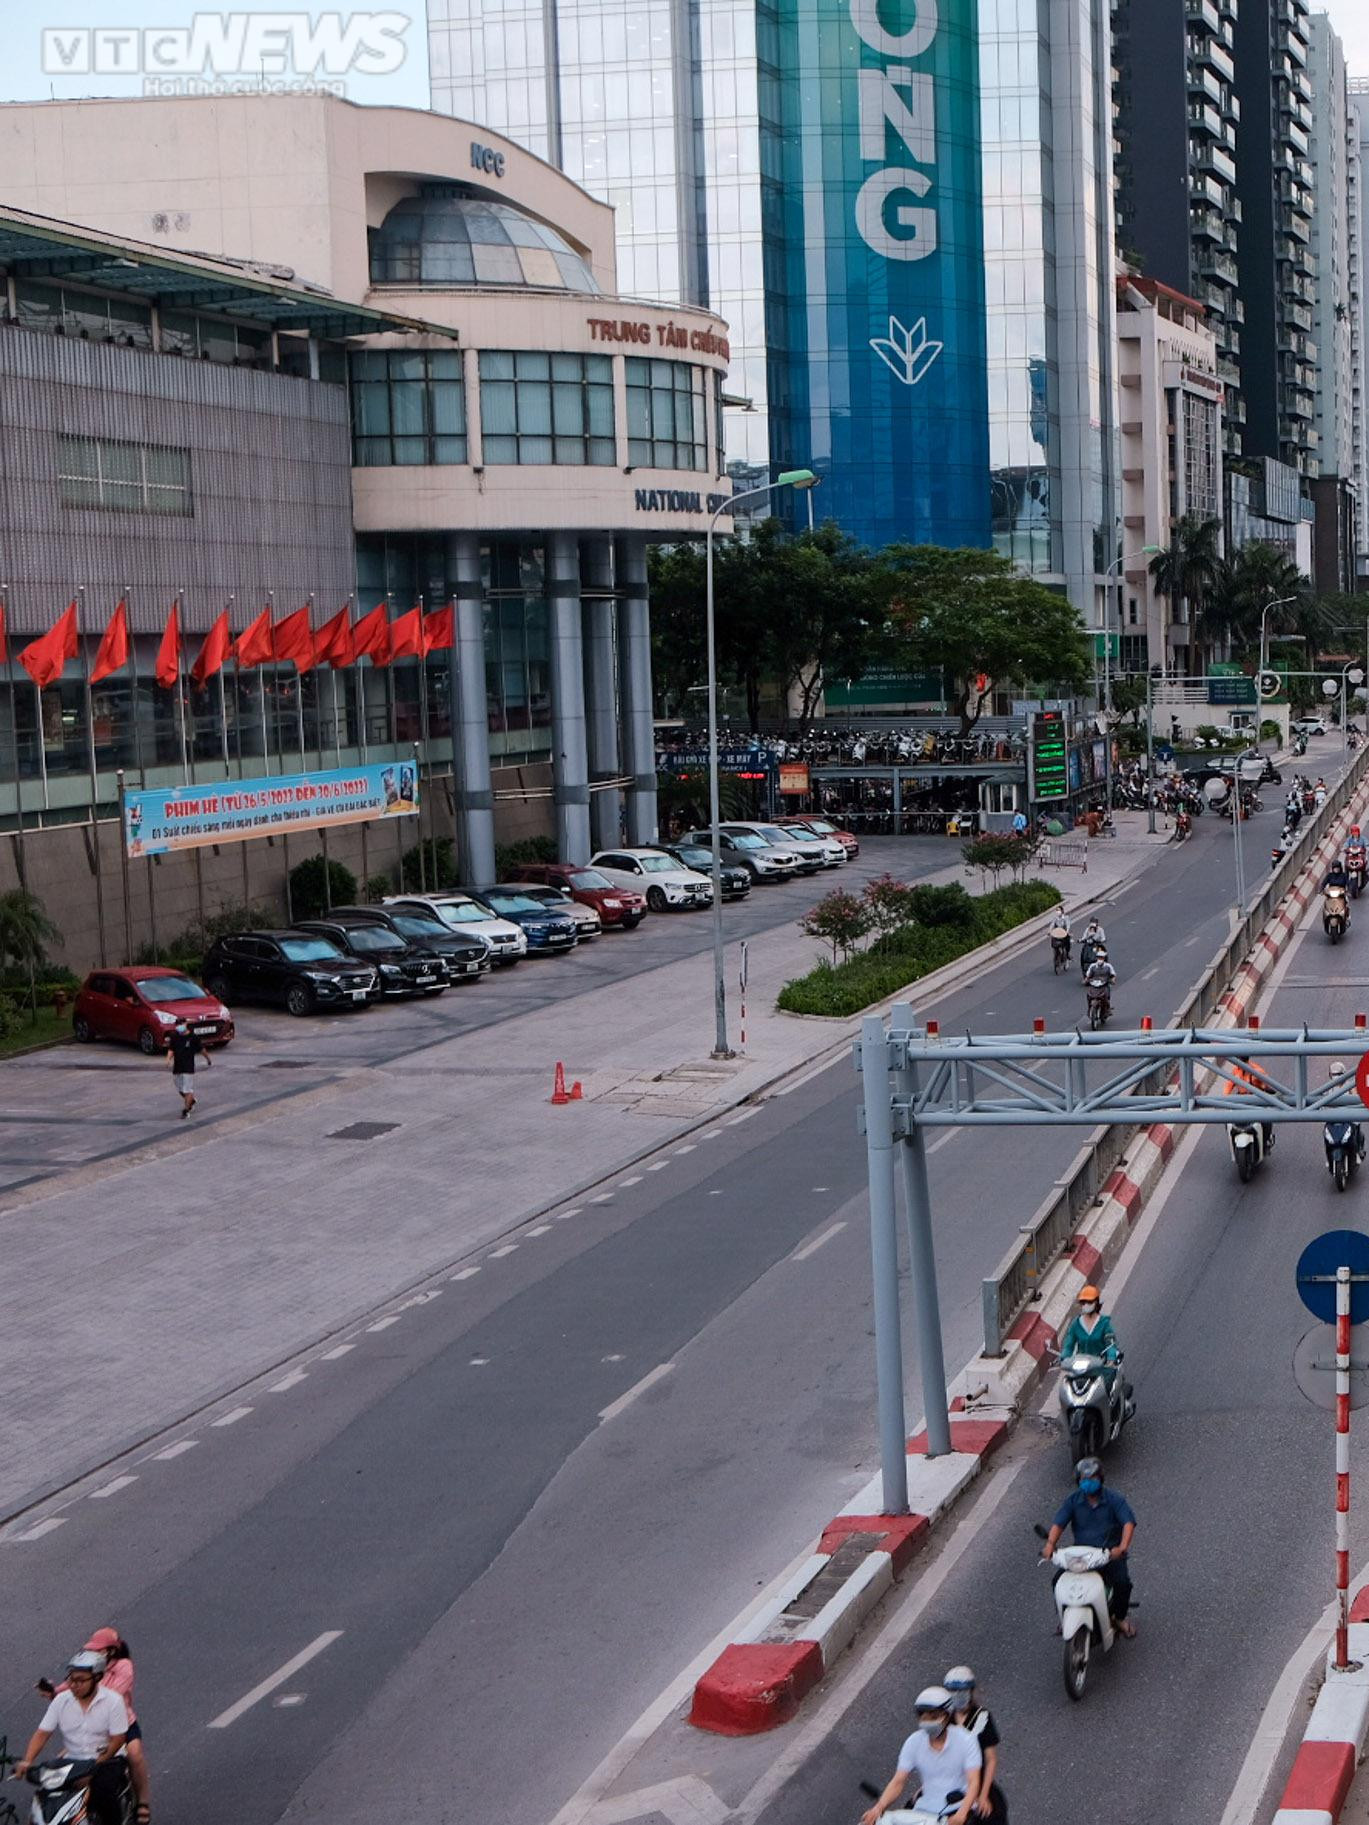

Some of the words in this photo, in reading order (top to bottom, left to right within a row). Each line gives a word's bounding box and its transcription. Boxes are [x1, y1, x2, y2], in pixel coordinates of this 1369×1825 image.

[471, 141, 505, 178] NCC
[587, 319, 651, 344] TRUNG
[656, 320, 688, 348] TÂM
[635, 488, 703, 513] NATIONAL
[165, 799, 201, 818] PHIM
